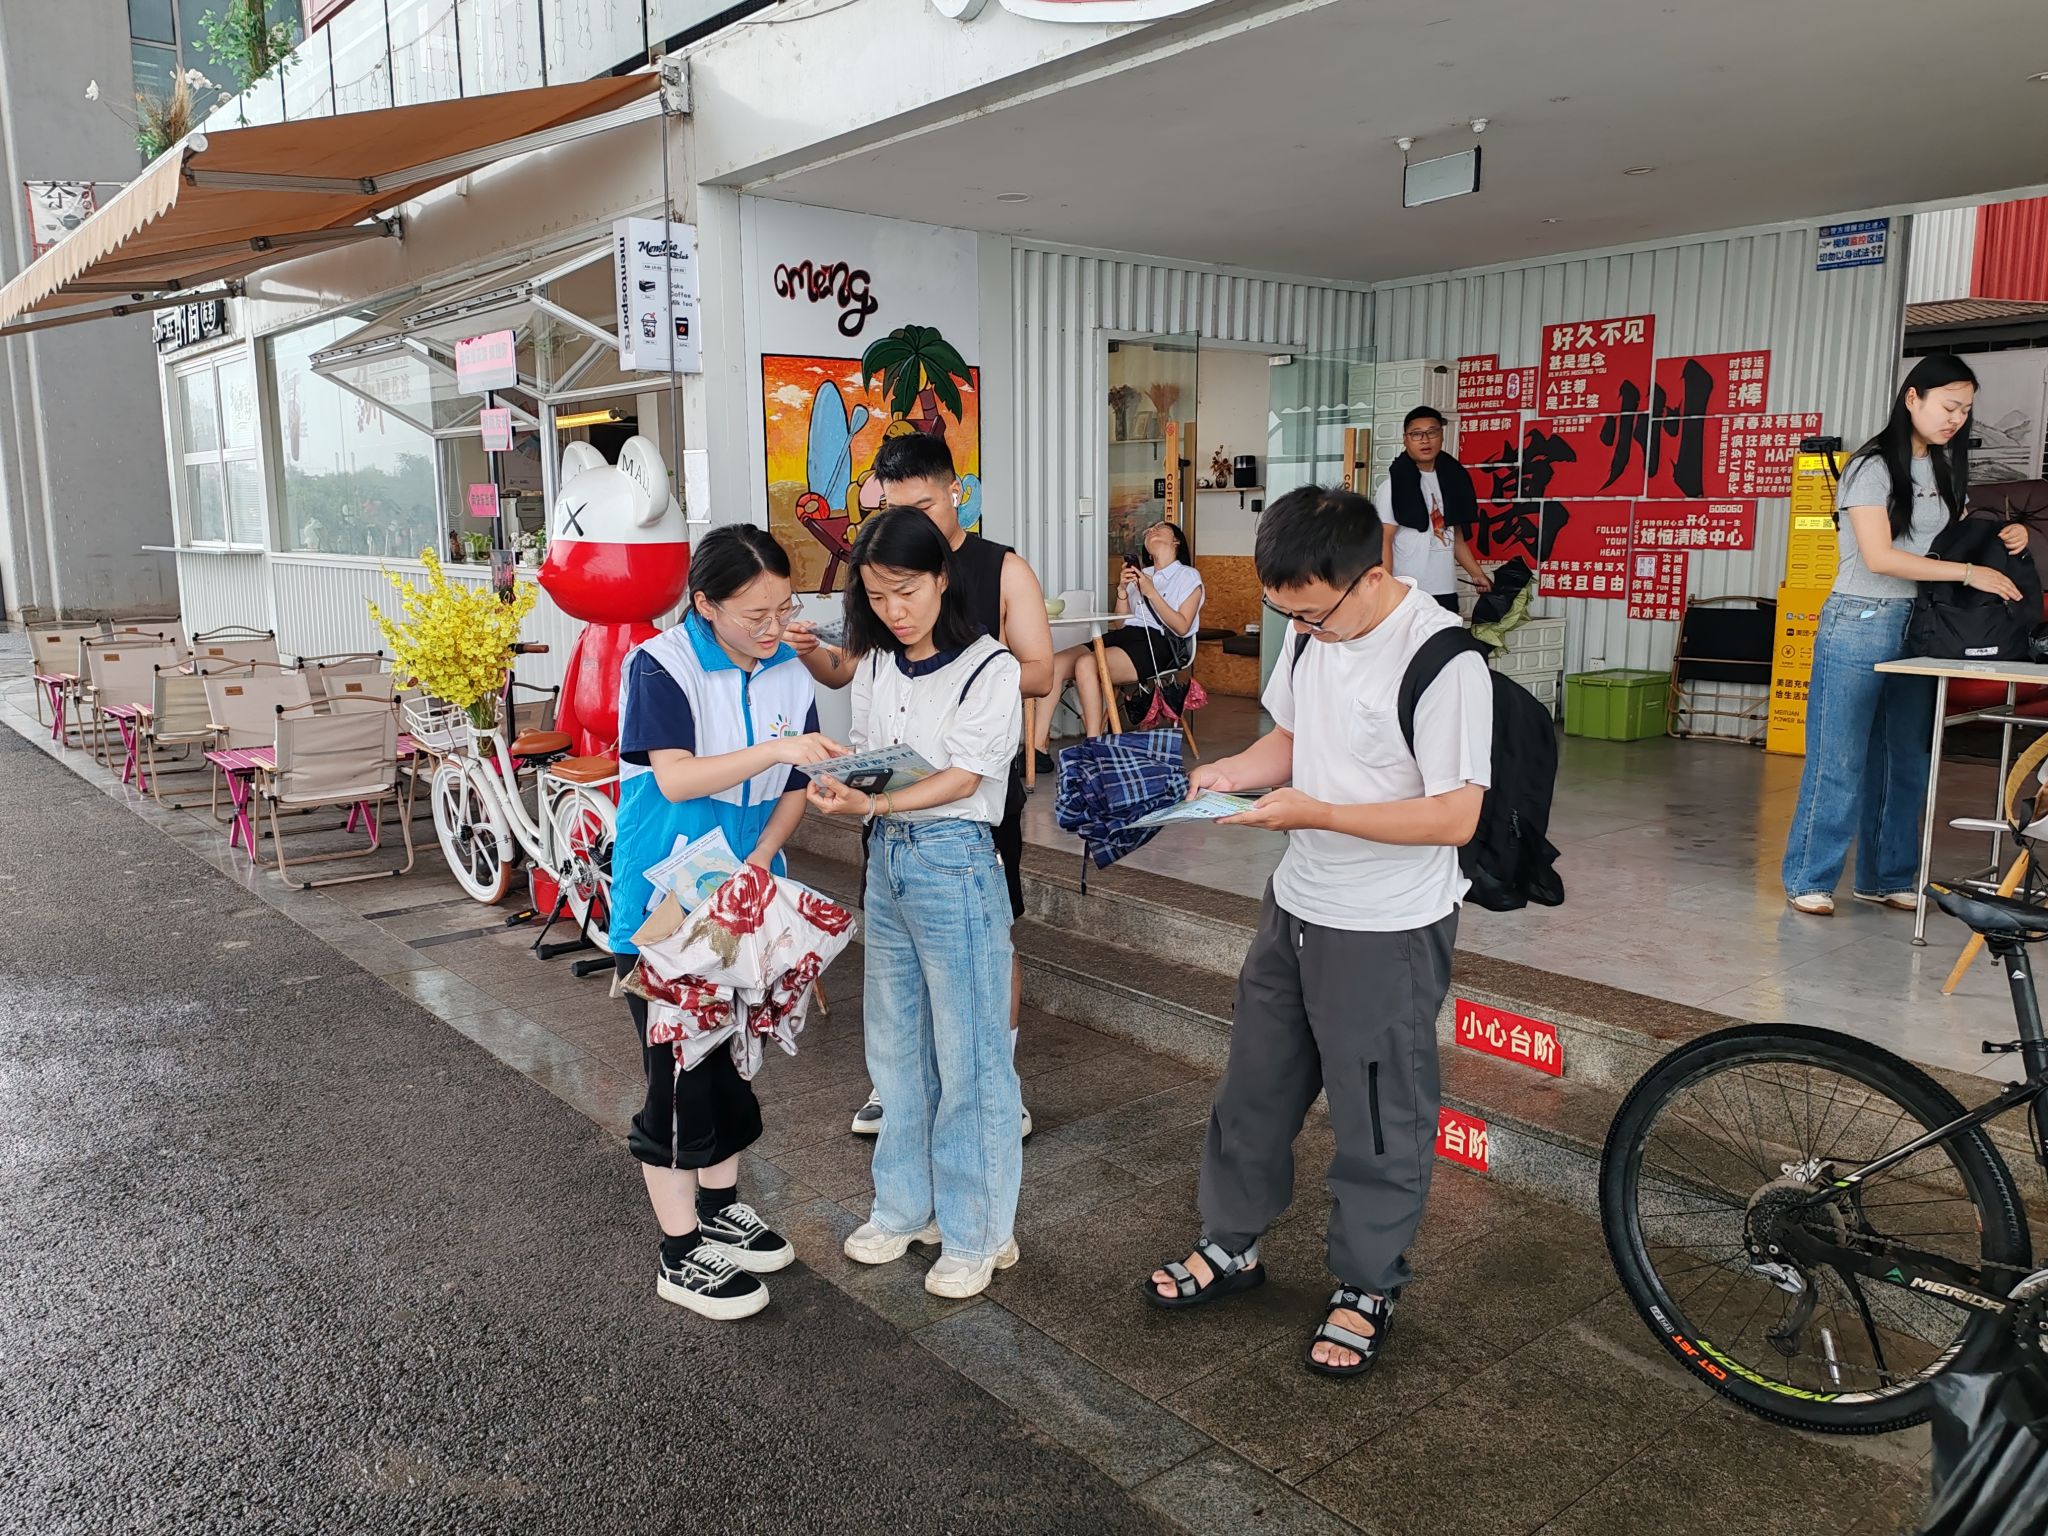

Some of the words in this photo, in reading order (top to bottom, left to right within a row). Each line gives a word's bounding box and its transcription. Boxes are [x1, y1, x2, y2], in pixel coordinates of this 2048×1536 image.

[1833, 233, 1884, 248] 视频监控区域
[1819, 248, 1869, 262] 切勿以身试法
[1551, 320, 1645, 351] 好久不见
[1460, 360, 1493, 373] 我肯定
[1549, 352, 1606, 370] 甚是想念
[1728, 356, 1765, 369] 时转运
[1459, 374, 1504, 387] 在几万年前
[1728, 369, 1764, 381] 诸事顺
[1458, 386, 1503, 398] 就说过爱你
[1547, 379, 1587, 395] 人生都
[1545, 394, 1599, 410] 是上上签
[1737, 382, 1762, 408] 棒
[1480, 400, 1506, 408] FREELY
[1732, 414, 1819, 431] 青春没有售价
[1708, 504, 1743, 513] GOGOGO
[1686, 514, 1710, 526] 开心
[1595, 526, 1628, 534] FOLLOW
[1641, 528, 1744, 546] 烦恼清除中心
[1600, 549, 1627, 557] HEART
[1540, 560, 1580, 571] 无需标签
[1583, 561, 1625, 571] 不被定义
[1540, 573, 1625, 592] 随性且自由
[1631, 592, 1668, 605] 定发财
[1629, 607, 1680, 620] 风水宝地
[1462, 1011, 1556, 1065] 小心台阶
[1437, 1119, 1489, 1163] 台阶
[1910, 1277, 2006, 1315] MERIDA
[1671, 1334, 1700, 1356] JET
[1697, 1359, 1727, 1381] CST
